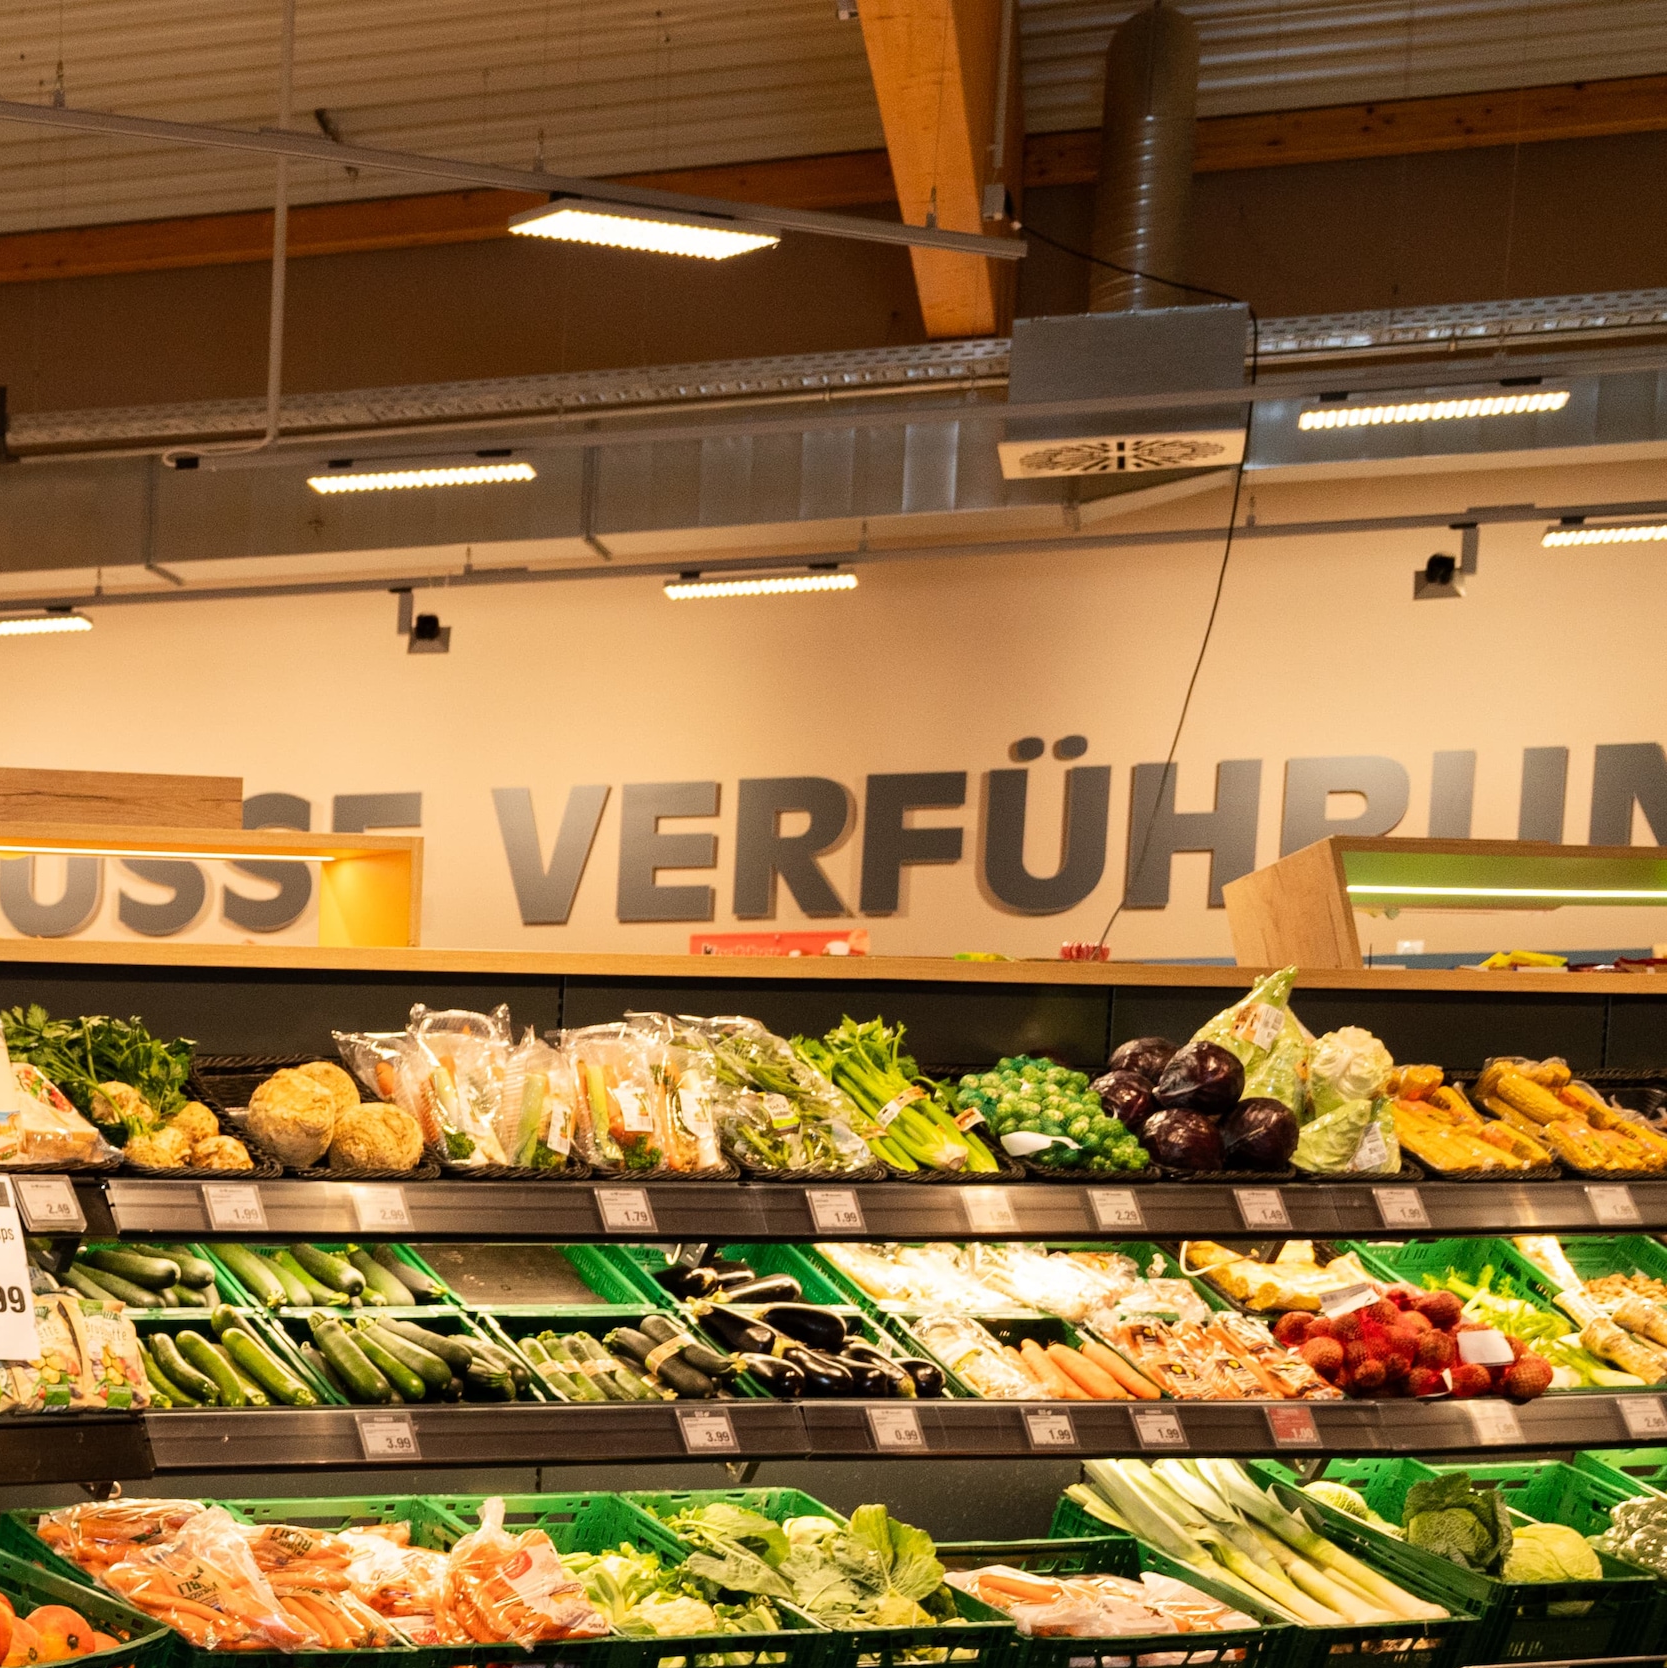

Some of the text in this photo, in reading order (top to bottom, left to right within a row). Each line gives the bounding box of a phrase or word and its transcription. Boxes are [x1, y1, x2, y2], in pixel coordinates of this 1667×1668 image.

[234, 1208, 258, 1220] 1.99
[380, 1209, 405, 1221] 2.99
[624, 1211, 648, 1222] 1.79
[835, 1212, 857, 1223] 1.99
[1116, 1210, 1137, 1221] 2.29
[1261, 1210, 1283, 1221] 1.49
[706, 1431, 730, 1442] 3.99
[895, 1430, 918, 1440] 0.99
[1049, 1430, 1071, 1440] 1.99
[1158, 1428, 1180, 1439] 1.99
[386, 1437, 412, 1449] 3.99
